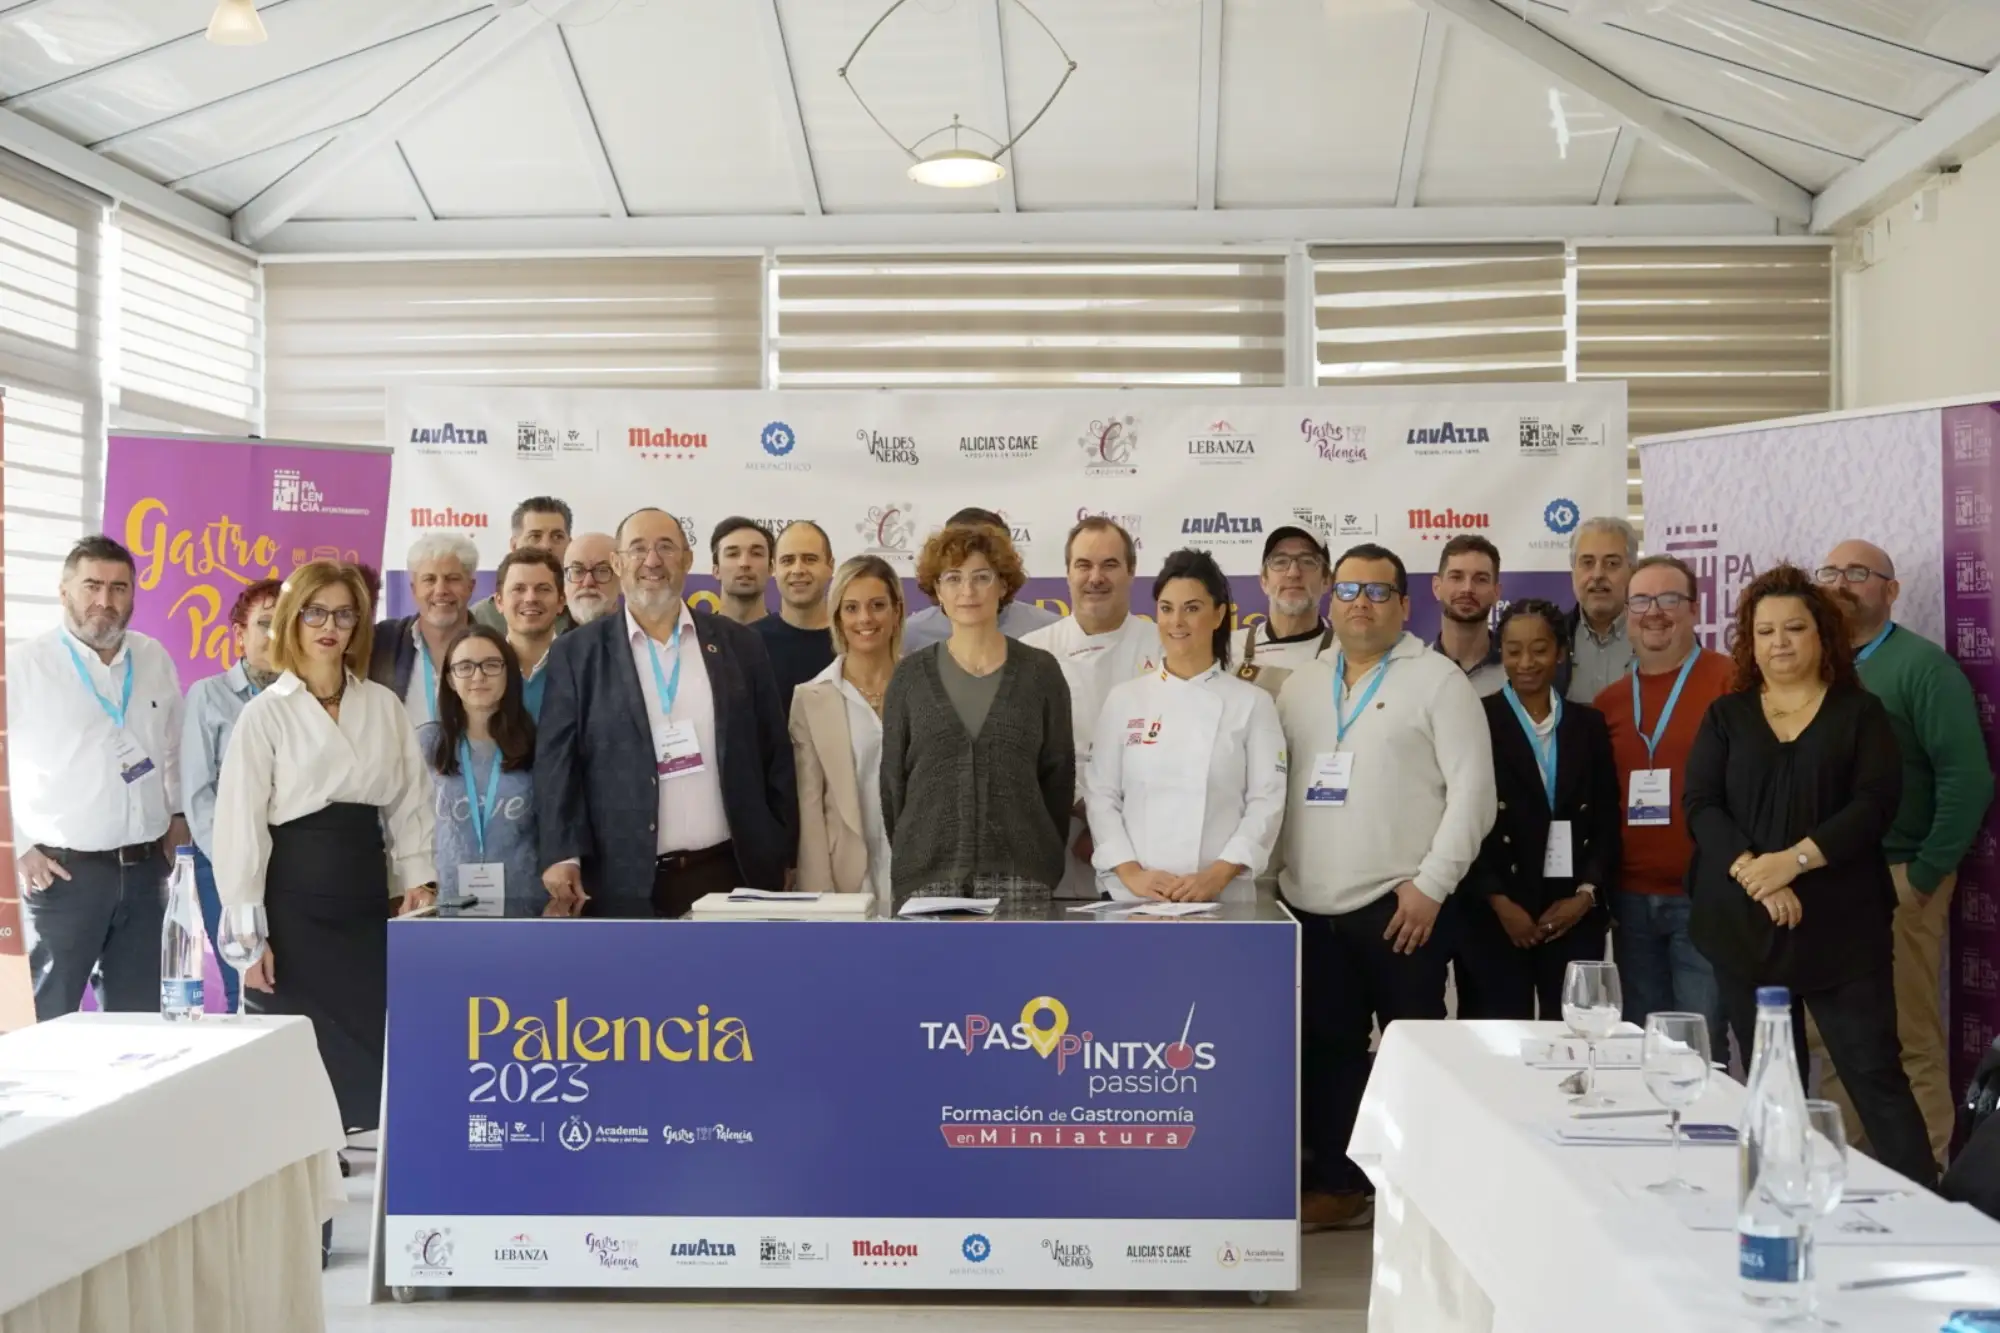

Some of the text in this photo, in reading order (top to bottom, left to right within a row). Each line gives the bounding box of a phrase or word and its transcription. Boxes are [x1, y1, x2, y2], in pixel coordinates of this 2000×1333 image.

[410, 422, 488, 444] LAVAZZA
[628, 427, 708, 448] Mahou
[1300, 417, 1344, 443] Gastro
[1406, 421, 1490, 445] LAVAZZA
[1541, 431, 1560, 439] LEN
[856, 429, 916, 455] VALDES
[959, 435, 1039, 451] ALICIA'S CAKE
[1188, 440, 1255, 454] LEBANZA
[1315, 439, 1368, 463] Palencia
[1541, 439, 1558, 447] CIA
[876, 450, 919, 466] NEROS
[301, 481, 316, 491] PA
[301, 491, 323, 502] LEN
[301, 502, 320, 512] CIA
[410, 507, 488, 528] Mahou
[1181, 511, 1263, 533] LAVAZZA
[1407, 507, 1490, 529] Mahou
[125, 496, 282, 591] Gastro
[1724, 553, 1755, 584] PA
[467, 996, 754, 1062] Palencia
[920, 1014, 1034, 1056] TAPAS
[468, 1061, 590, 1104] 2023
[941, 1105, 1195, 1122] Formación de Gastronomía
[566, 1126, 585, 1142] A
[595, 1125, 649, 1136] Academia
[712, 1123, 754, 1145] Palencia
[956, 1127, 1178, 1145] en Miniatura
[494, 1249, 549, 1261] LEBANZA
[670, 1238, 737, 1256] LAVAZZA
[852, 1239, 918, 1257] Mahou
[1041, 1238, 1091, 1261] VALDES
[1126, 1245, 1192, 1258] ALICIA'S CAKE
[598, 1249, 639, 1270] Palencia
[1057, 1256, 1094, 1270] NEROS
